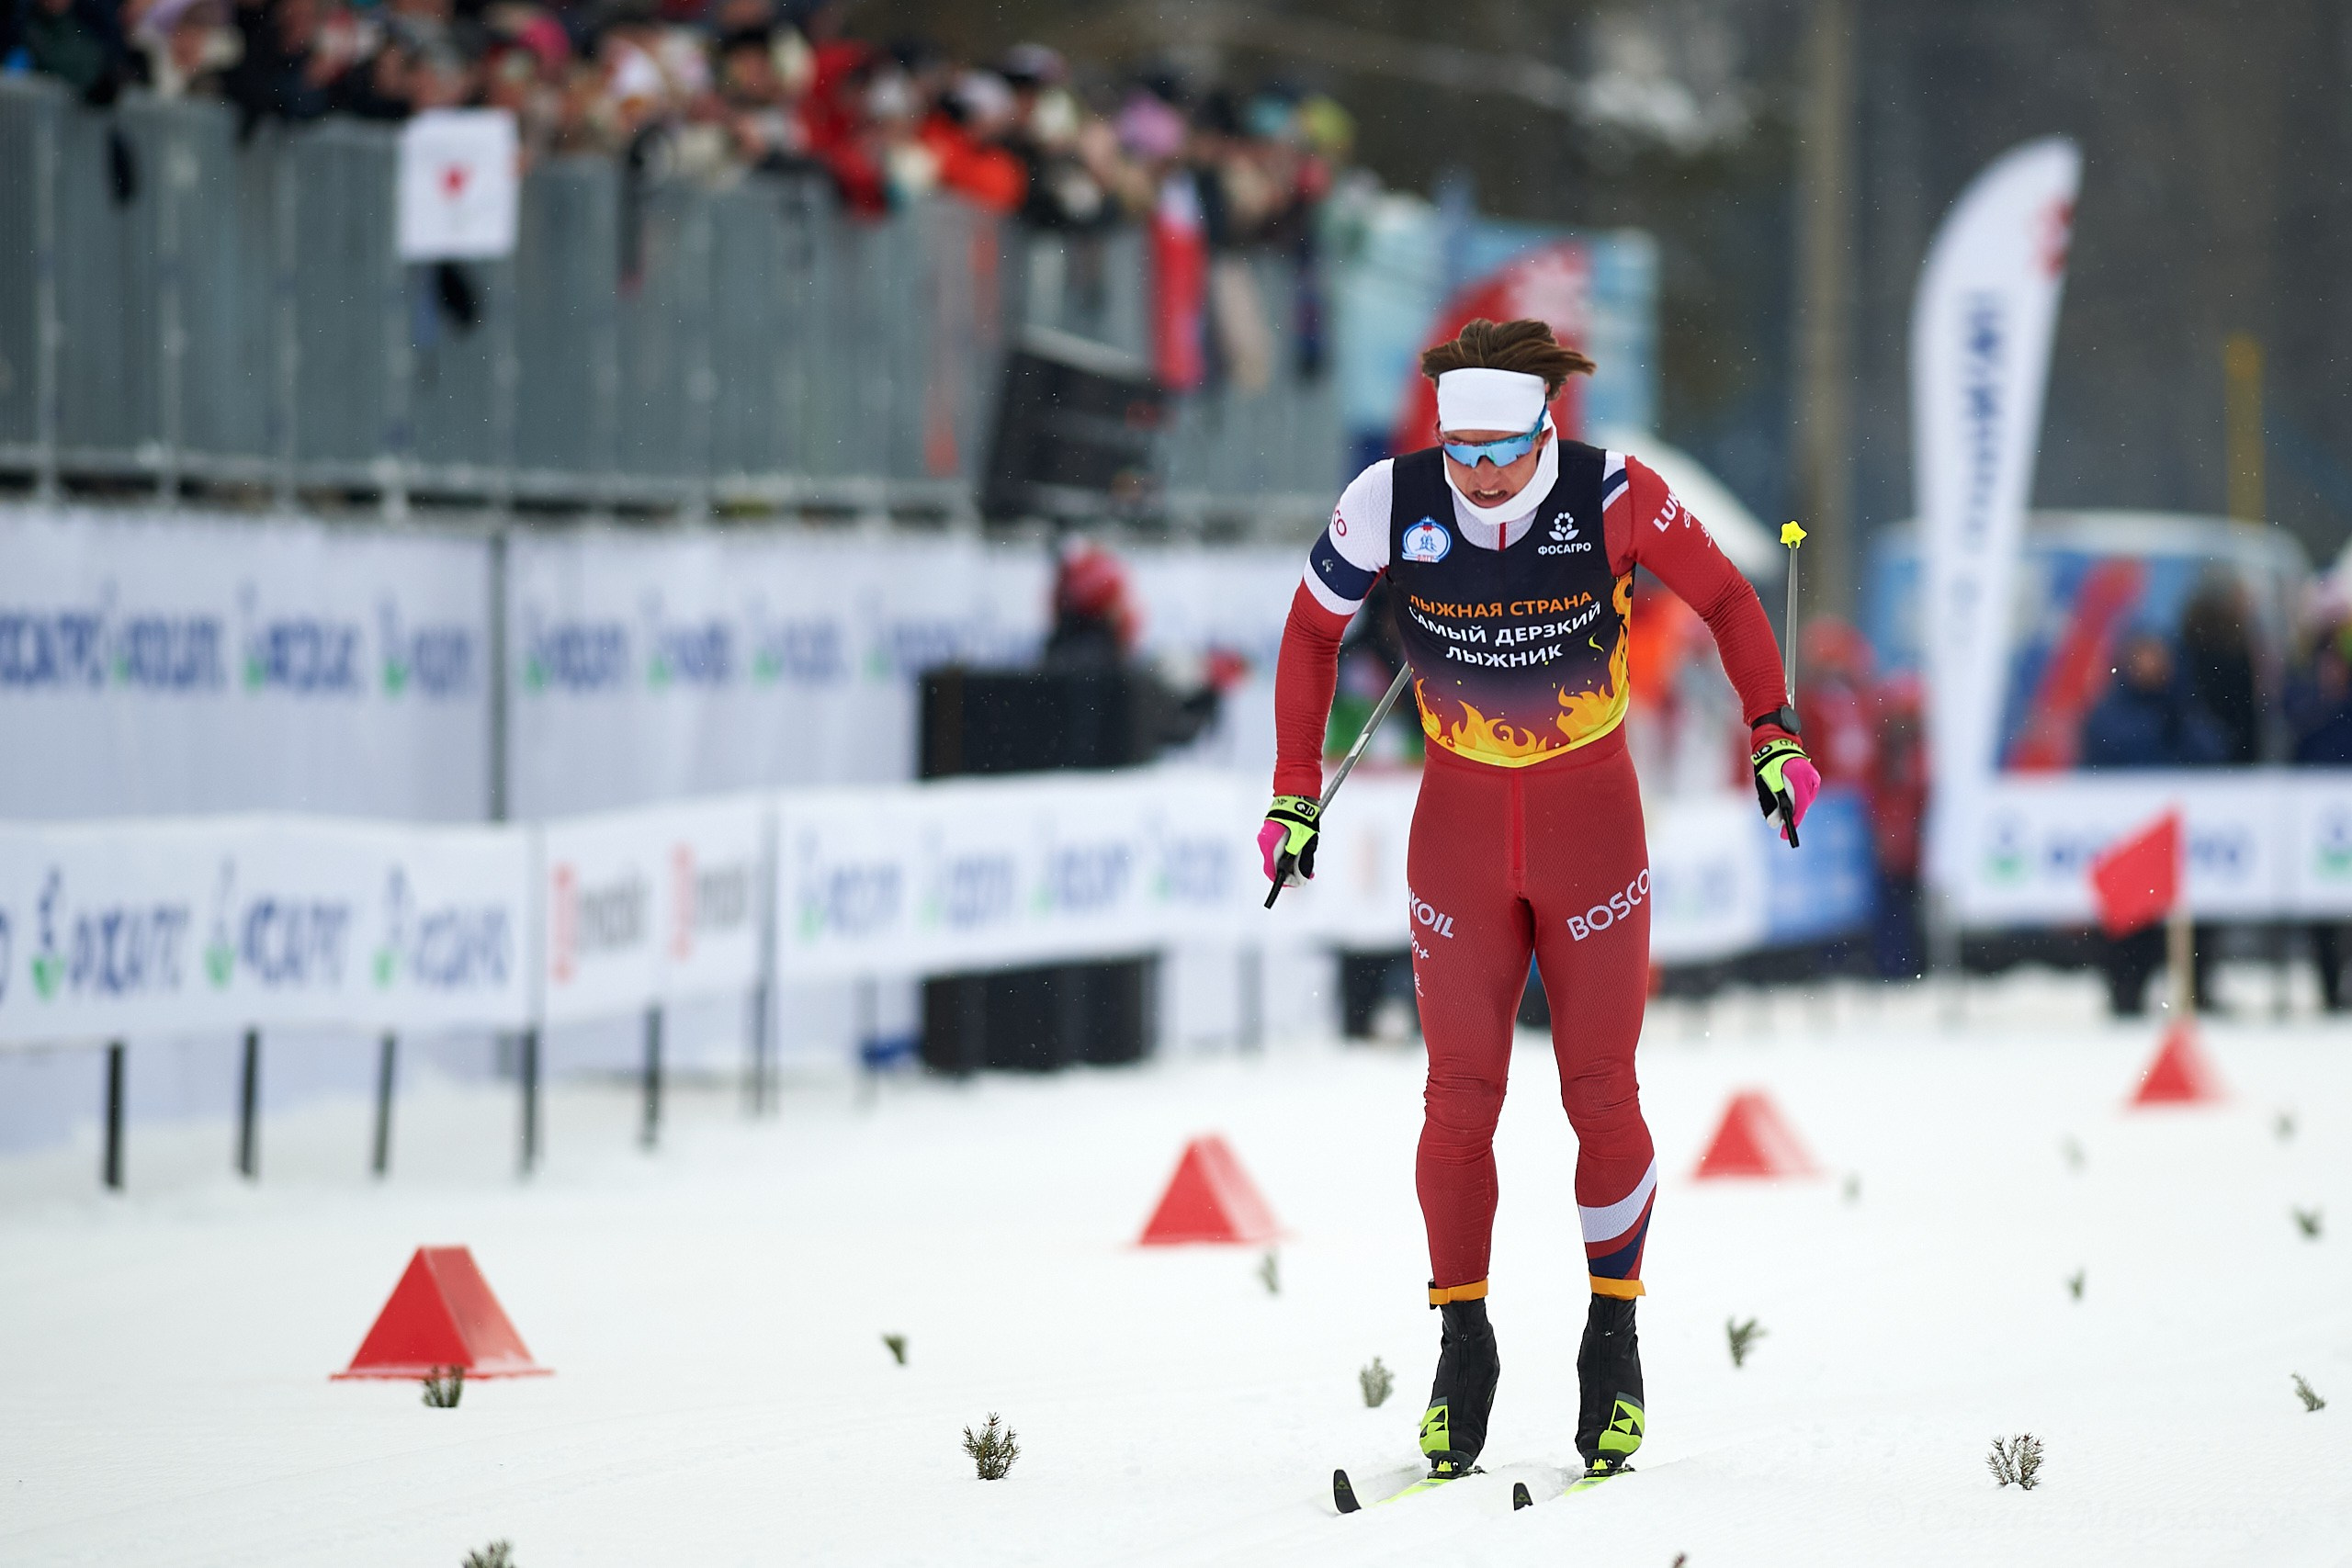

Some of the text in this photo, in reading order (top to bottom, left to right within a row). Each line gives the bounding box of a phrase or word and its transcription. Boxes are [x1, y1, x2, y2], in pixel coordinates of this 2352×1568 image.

[1537, 542, 1592, 556] ФОСАГРО
[1409, 591, 1593, 618] ЛЫЖНАЯ СТРАНА
[1408, 600, 1601, 647] САМЫЙ ДЕРЗКИЙ
[1445, 643, 1564, 668] ЛЫЖНИК
[1566, 868, 1649, 942] BOSCO
